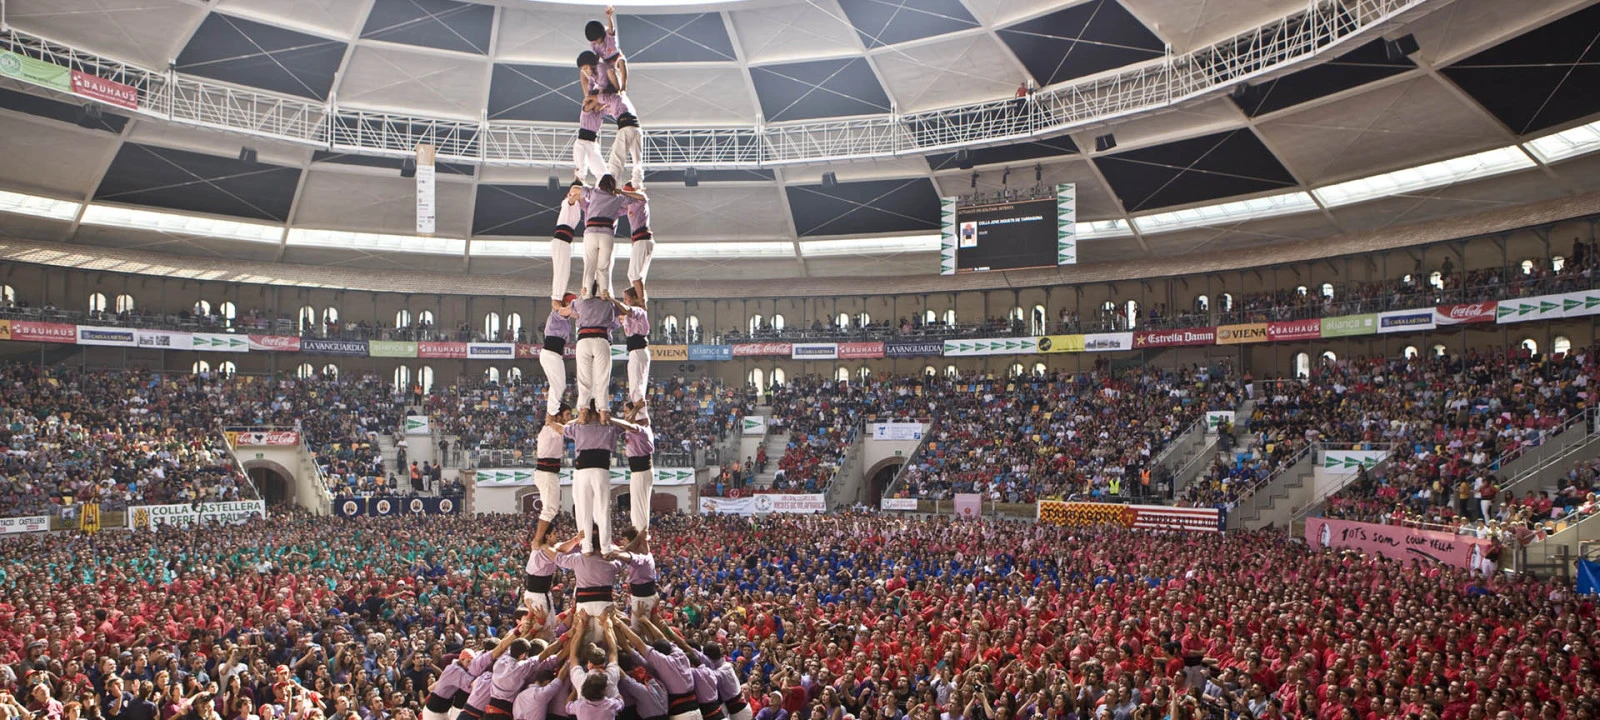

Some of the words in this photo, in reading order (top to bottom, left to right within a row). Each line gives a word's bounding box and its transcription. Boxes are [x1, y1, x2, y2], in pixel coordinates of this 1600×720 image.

[84, 79, 136, 101] BAUHAUS
[23, 326, 75, 337] BAUHAUS
[1232, 328, 1267, 338] VIENA
[1275, 323, 1319, 334] BAUHAUS
[1148, 333, 1183, 343] Estrella
[1184, 331, 1214, 342] Damm
[315, 342, 366, 352] VANGUARDIA
[895, 344, 941, 353] VANGUARDIA
[656, 349, 687, 357] VIENA
[152, 505, 189, 515] COLLA
